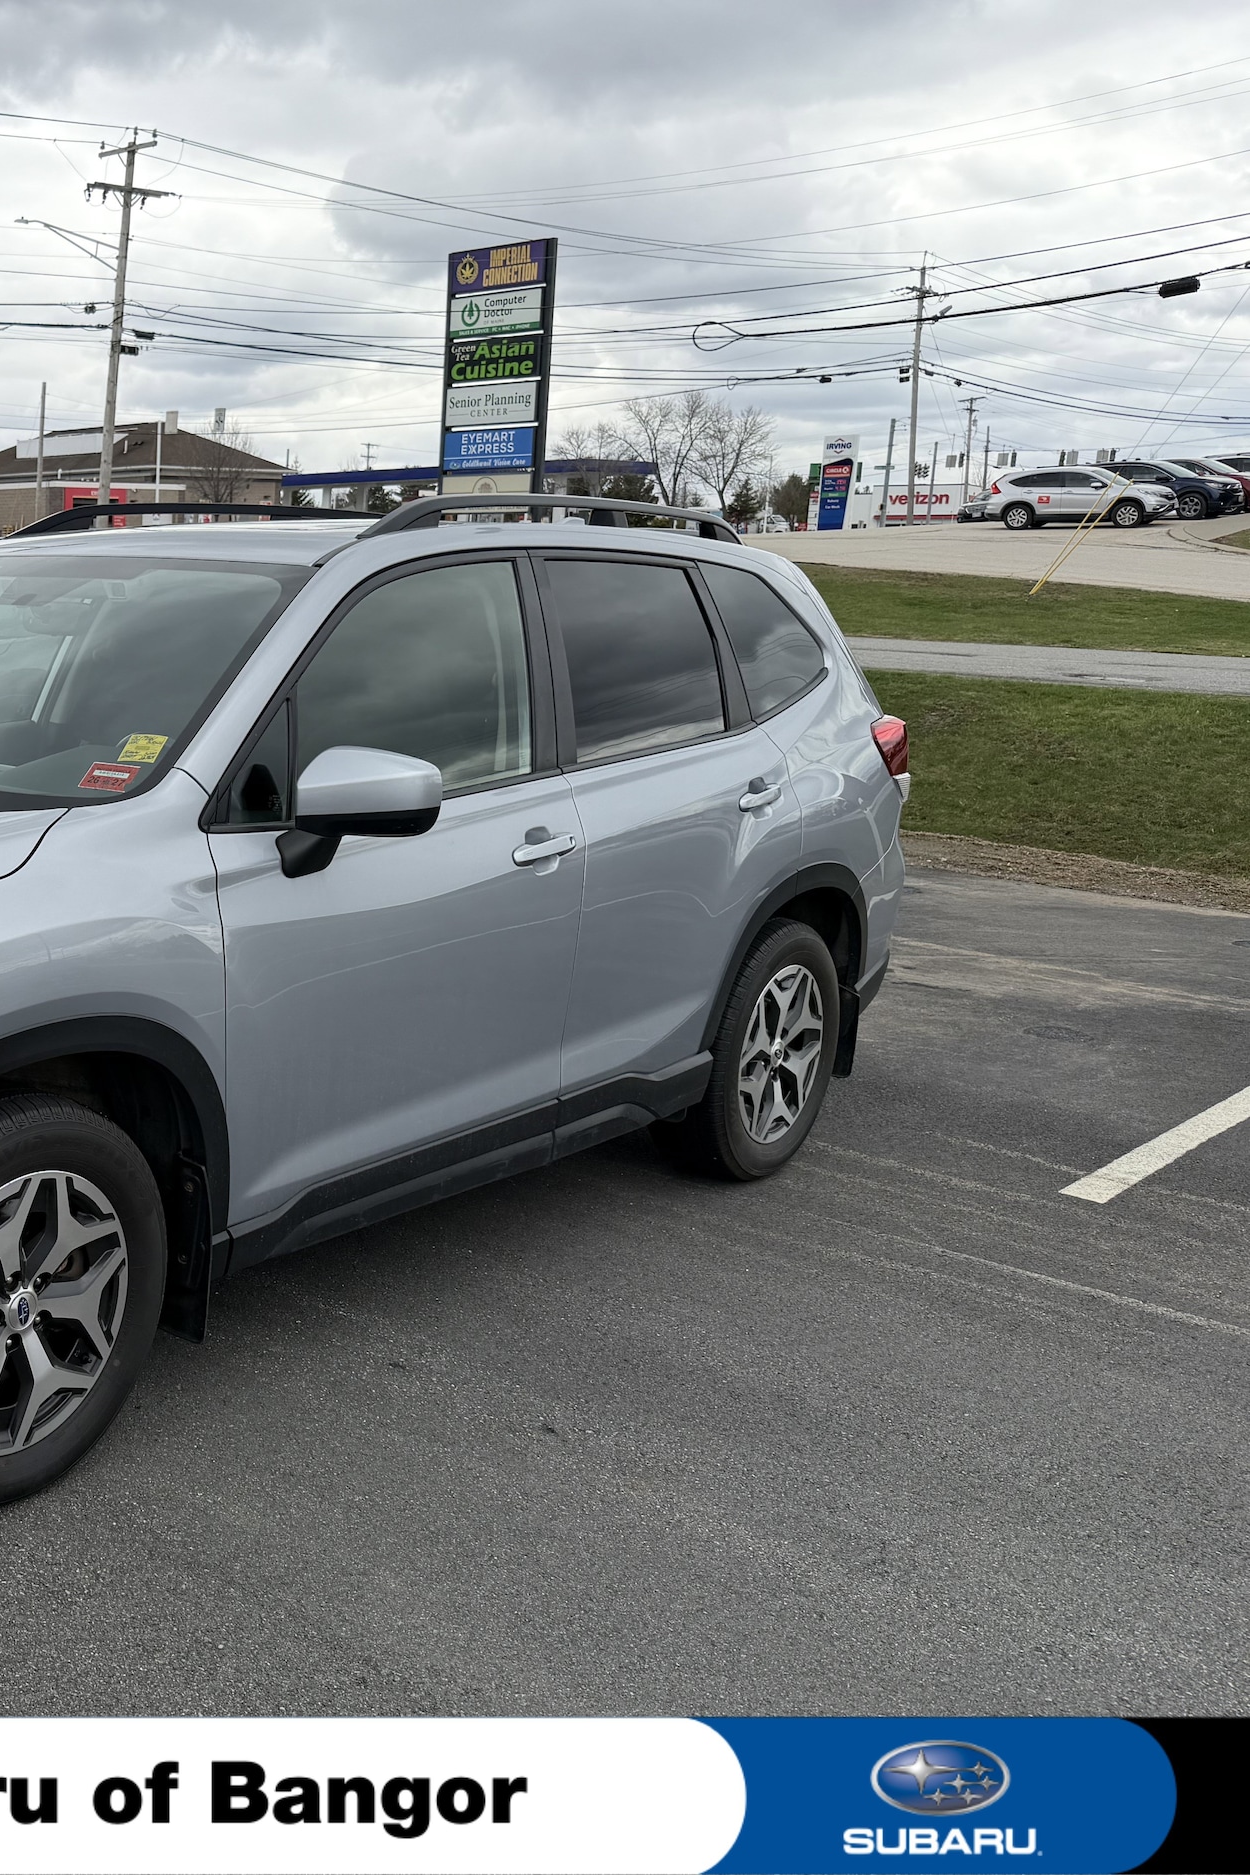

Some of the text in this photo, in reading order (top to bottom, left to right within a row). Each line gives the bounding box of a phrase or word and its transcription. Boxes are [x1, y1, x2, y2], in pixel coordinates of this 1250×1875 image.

[490, 244, 531, 267] IMPERIAL
[483, 262, 538, 287] CONNECTION
[484, 295, 527, 308] Computer
[484, 308, 513, 318] Doctor
[451, 345, 476, 353] Green
[473, 340, 535, 360] Asian
[455, 352, 470, 361] Tea
[451, 359, 533, 380] Cuisine
[449, 392, 531, 409] Senior Planning
[470, 408, 508, 417] CENTER
[461, 431, 515, 444] EYEMART
[461, 442, 514, 455] EXPRESS
[826, 442, 852, 450] IRVING
[493, 459, 511, 467] Vision
[512, 458, 526, 466] Care
[889, 491, 950, 505] veizon
